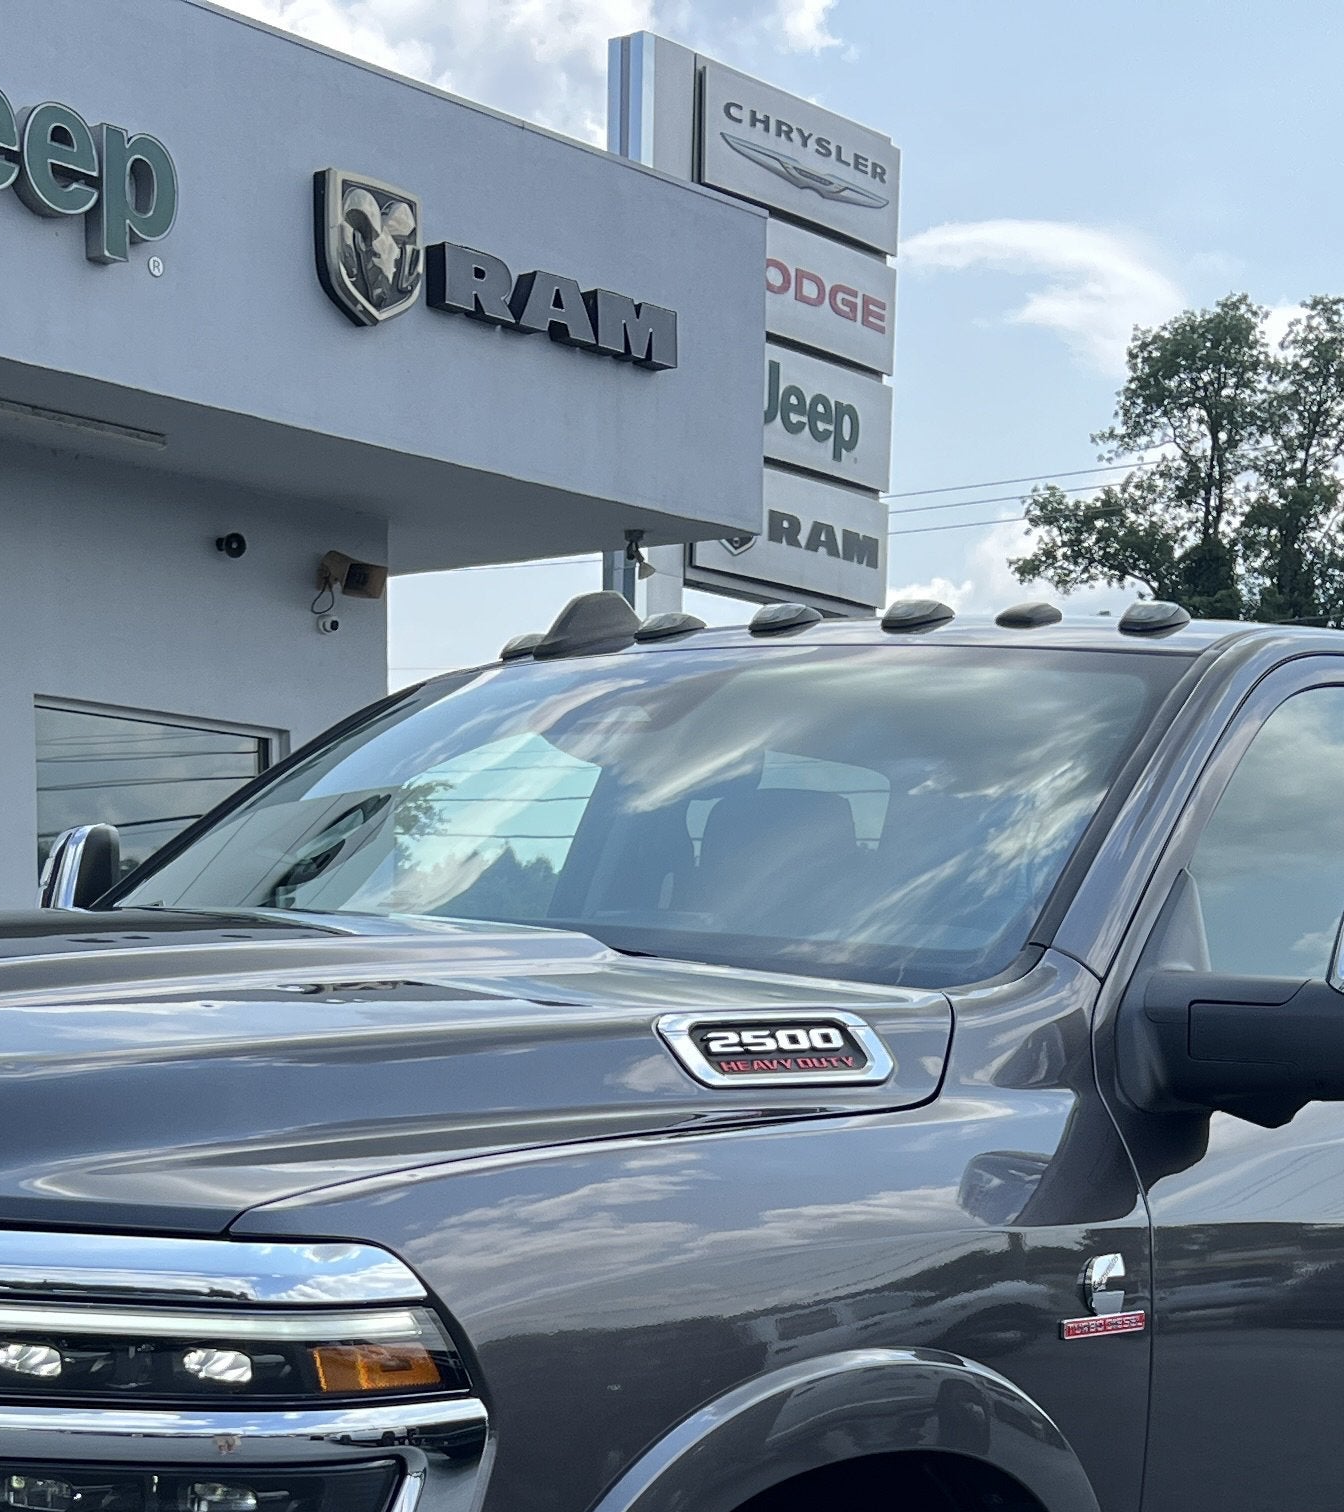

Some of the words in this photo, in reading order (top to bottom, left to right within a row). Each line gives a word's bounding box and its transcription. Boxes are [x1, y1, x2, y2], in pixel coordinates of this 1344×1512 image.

[723, 101, 888, 185] CHRYSLER
[426, 241, 678, 371] RAM
[765, 257, 887, 335] ODGE
[763, 359, 860, 463] Jeep
[767, 508, 879, 570] RAM
[704, 1027, 844, 1053] 2500
[720, 1057, 793, 1073] HEAVY
[796, 1056, 855, 1070] DUTY
